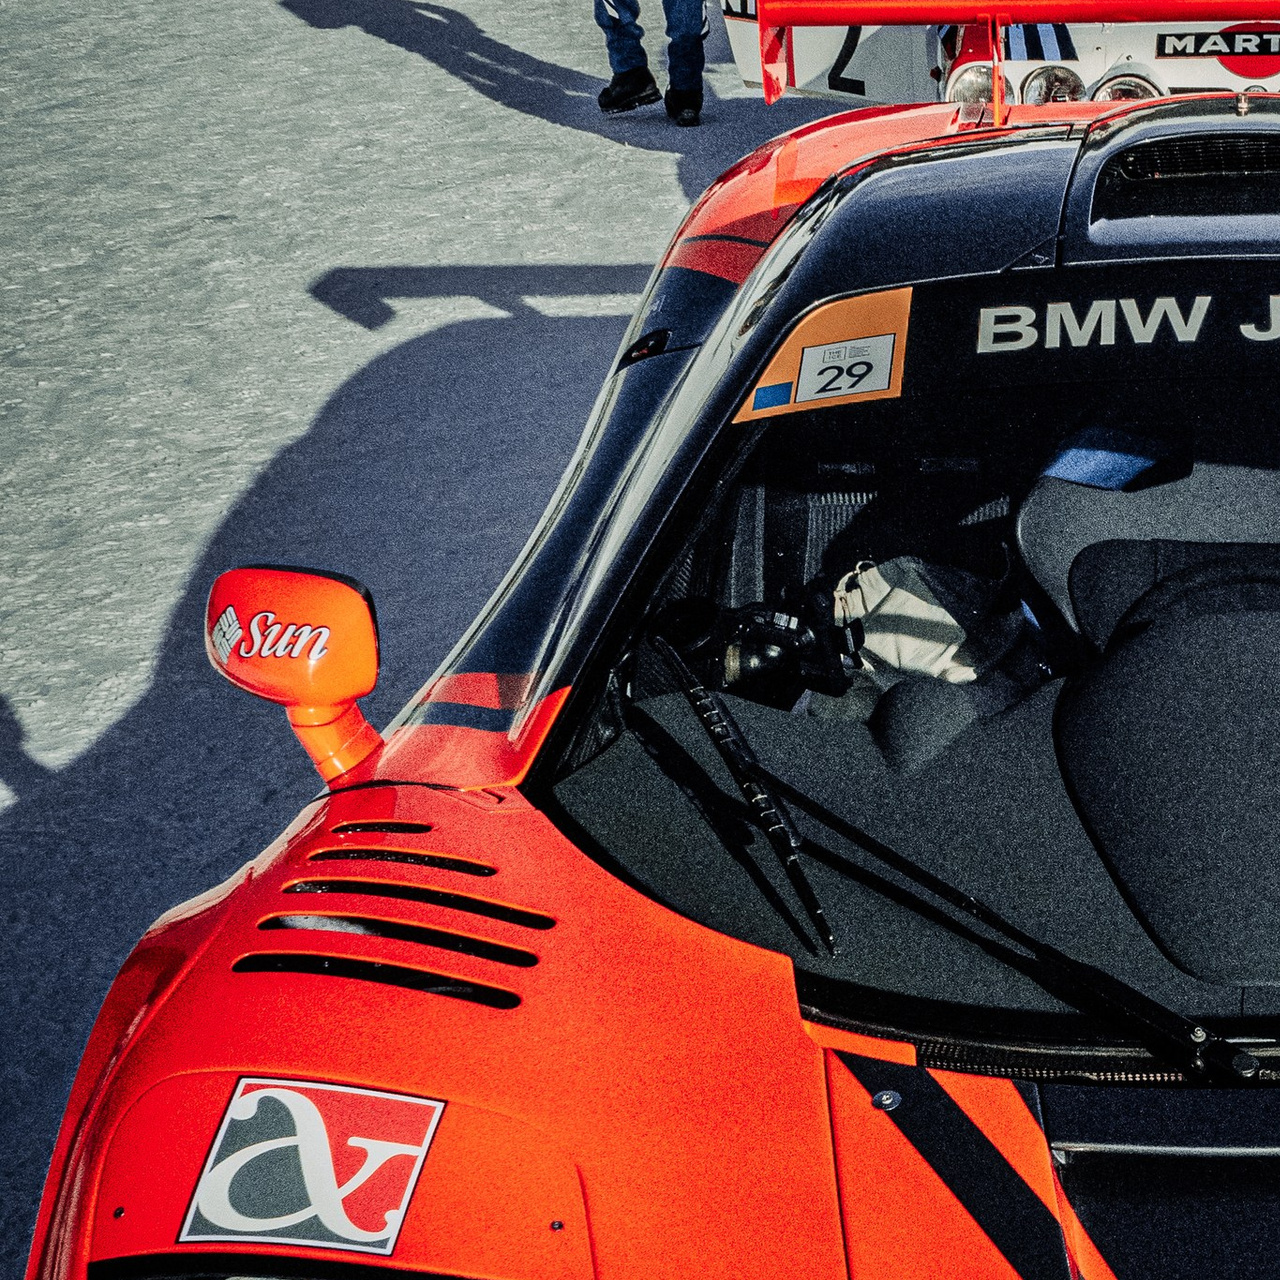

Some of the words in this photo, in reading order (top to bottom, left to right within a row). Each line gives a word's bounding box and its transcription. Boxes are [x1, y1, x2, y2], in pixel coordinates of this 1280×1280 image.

[976, 295, 1212, 353] BMW
[814, 360, 874, 395] 29
[239, 611, 331, 660] Sun
